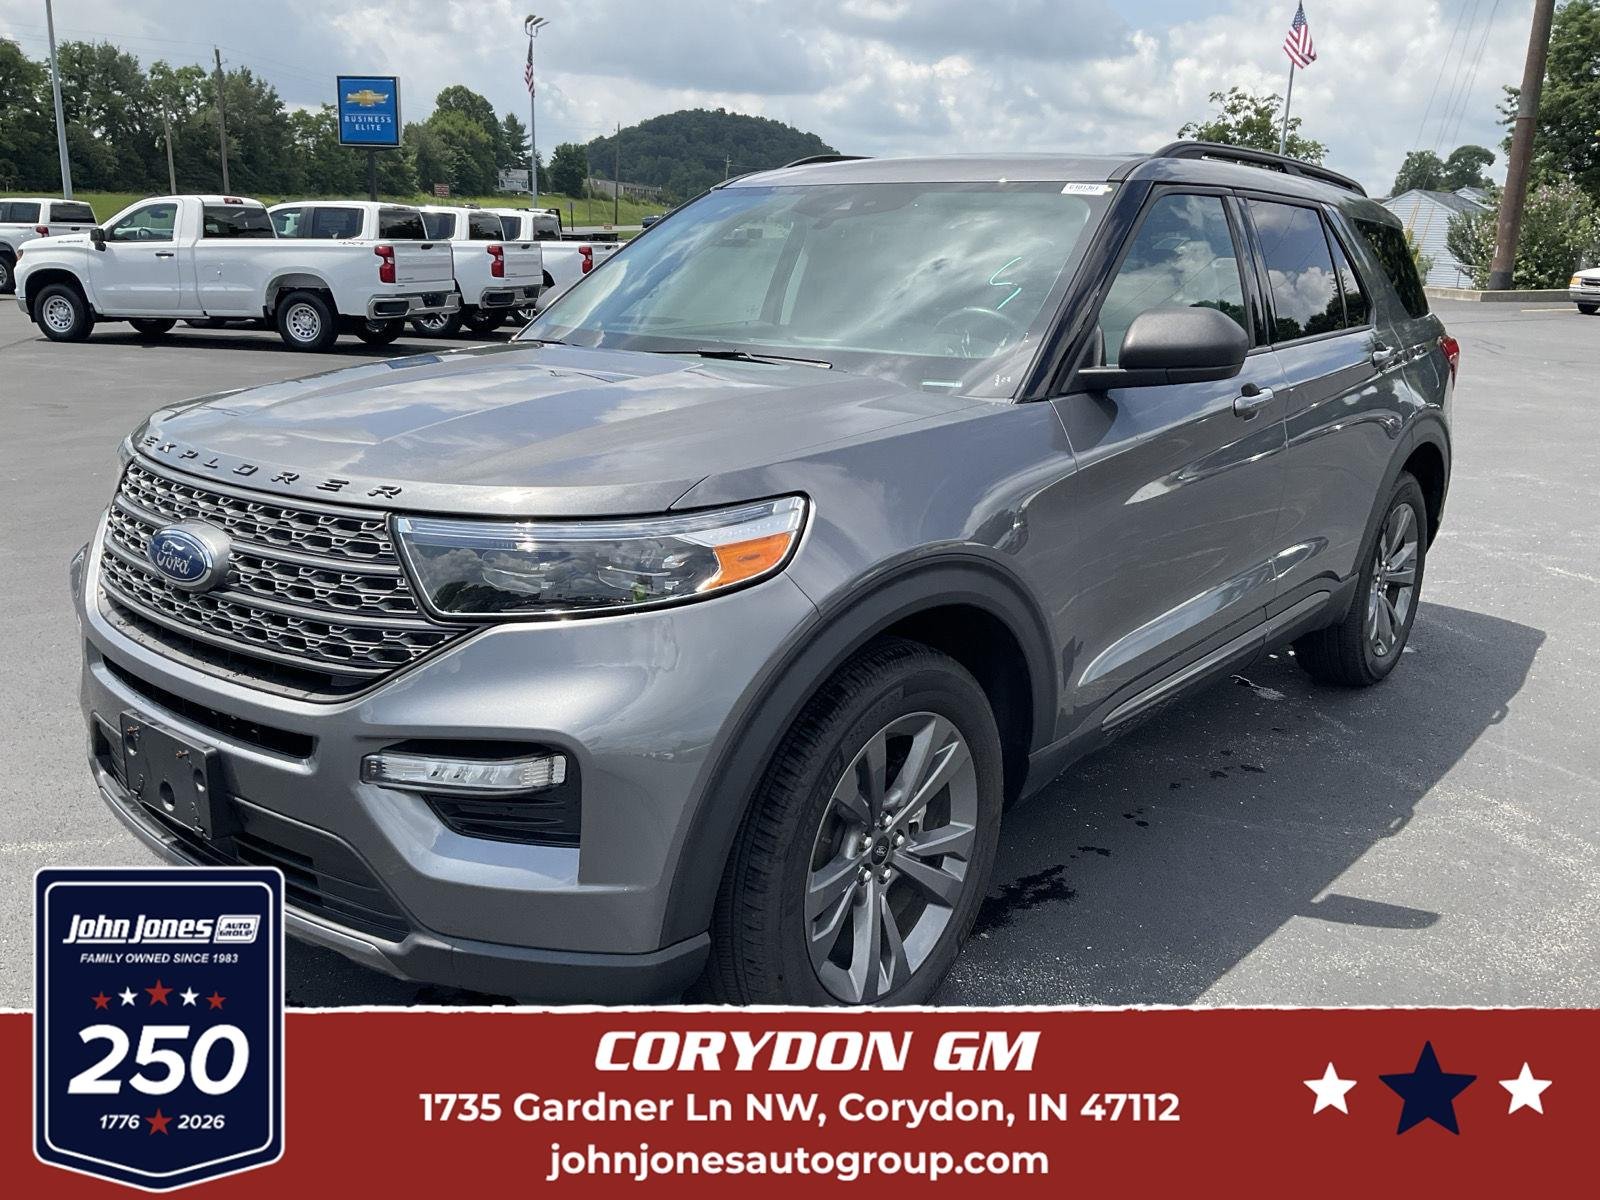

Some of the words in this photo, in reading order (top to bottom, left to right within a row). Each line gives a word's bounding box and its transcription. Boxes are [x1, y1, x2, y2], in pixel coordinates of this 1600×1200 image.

[344, 115, 392, 123] BUSINESS
[143, 435, 403, 499] EXPLORER
[156, 539, 194, 576] Ford
